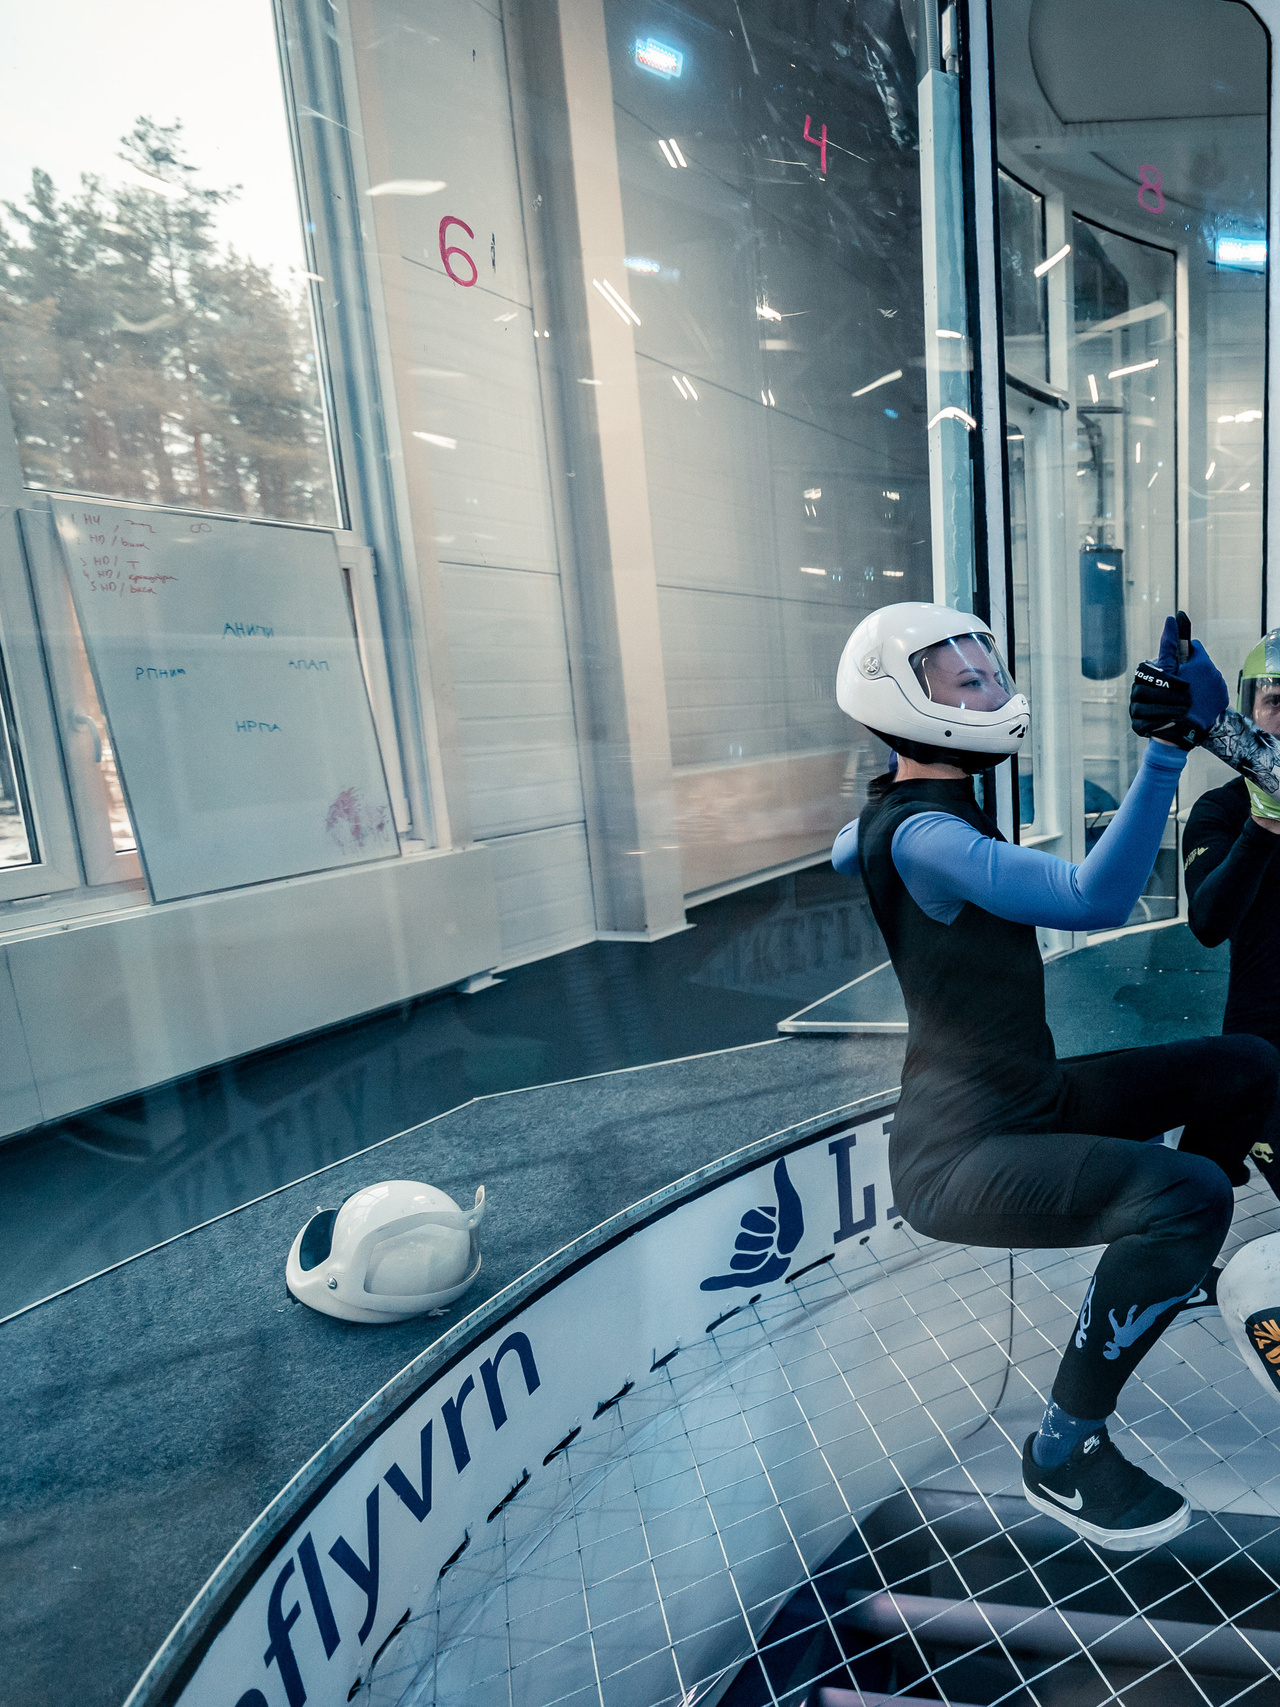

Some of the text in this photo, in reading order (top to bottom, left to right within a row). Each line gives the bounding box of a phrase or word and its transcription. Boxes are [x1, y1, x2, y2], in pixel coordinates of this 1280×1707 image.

[803, 115, 828, 174] 4
[1137, 165, 1165, 213] 8
[438, 215, 478, 287] 6
[234, 1331, 542, 1707] flyvrn
